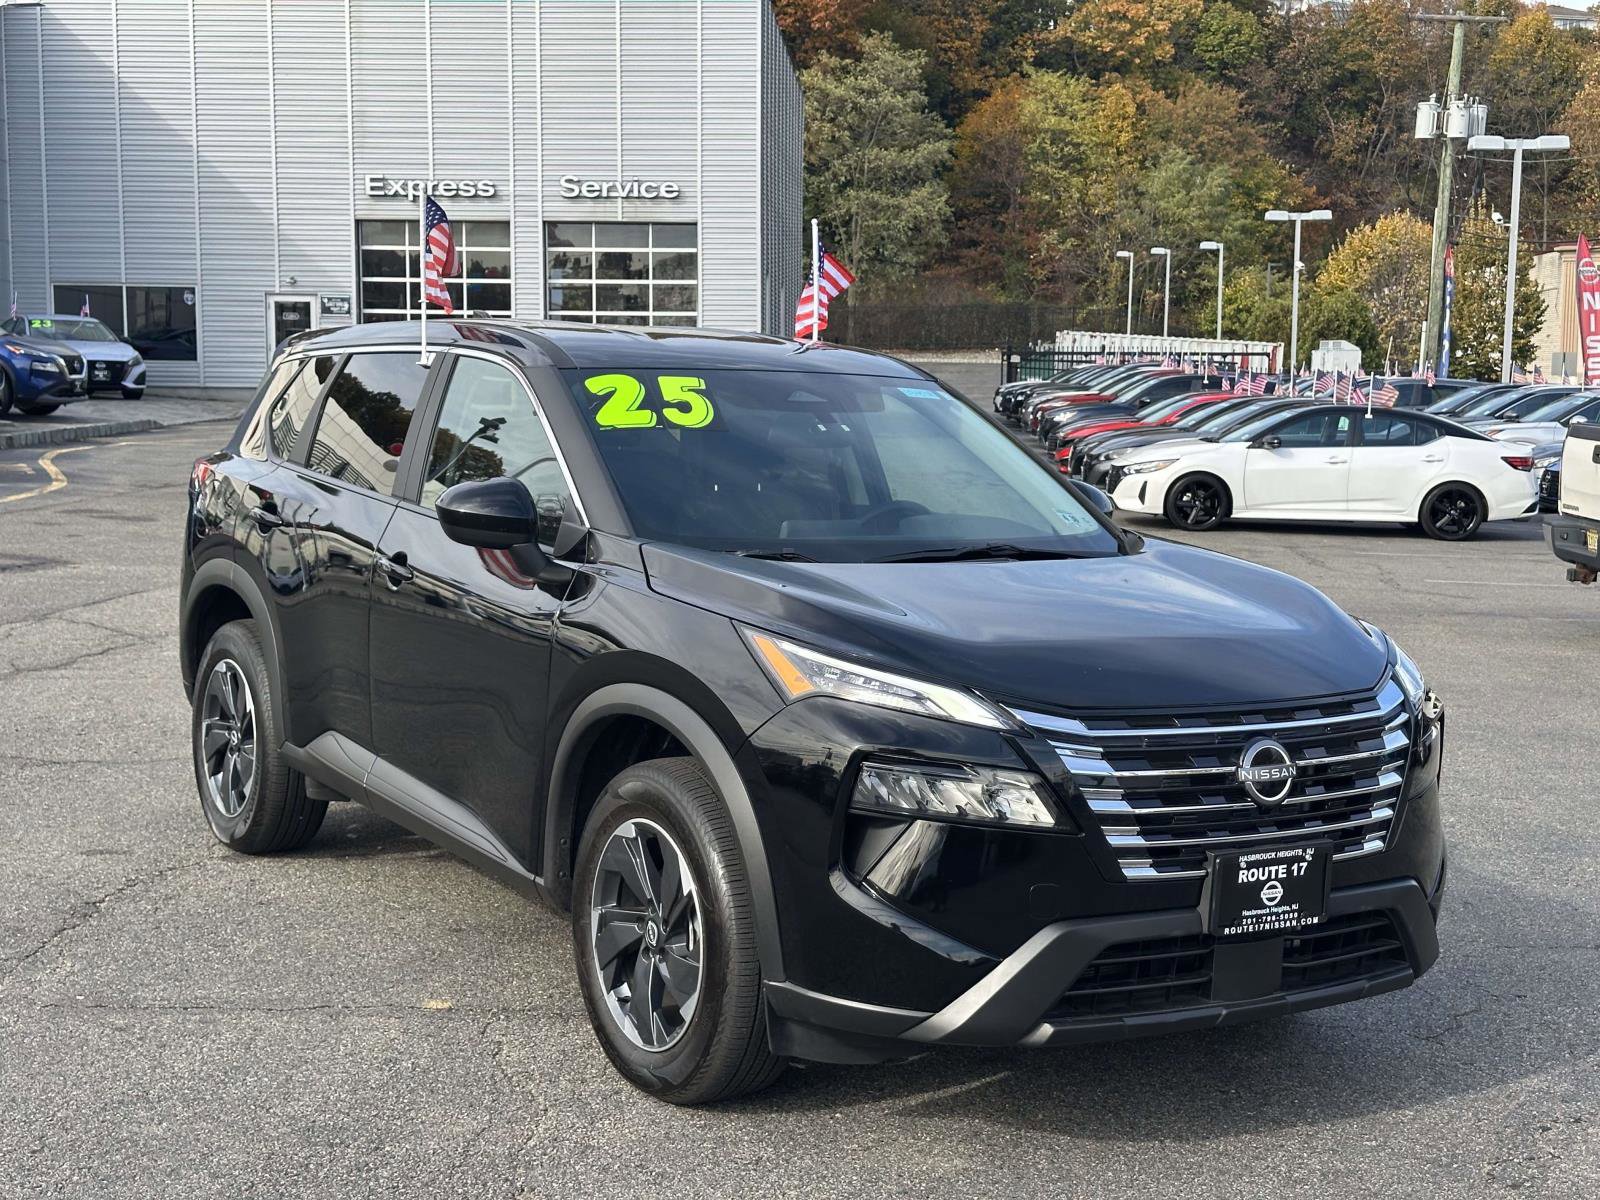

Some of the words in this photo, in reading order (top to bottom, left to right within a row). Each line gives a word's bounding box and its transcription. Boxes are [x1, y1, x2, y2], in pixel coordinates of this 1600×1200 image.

[364, 174, 496, 200] Express
[559, 175, 680, 198] Service
[31, 320, 52, 328] 23
[584, 374, 714, 428] 25
[1242, 766, 1297, 780] NISSAN
[1239, 851, 1276, 863] HASBROUCK
[1306, 847, 1315, 855] NJ
[1238, 864, 1288, 884] ROUTE
[1291, 862, 1308, 876] 17
[1242, 907, 1270, 916] Hasbrouck
[1224, 916, 1319, 935] ROUTE17NISSAN.COM
